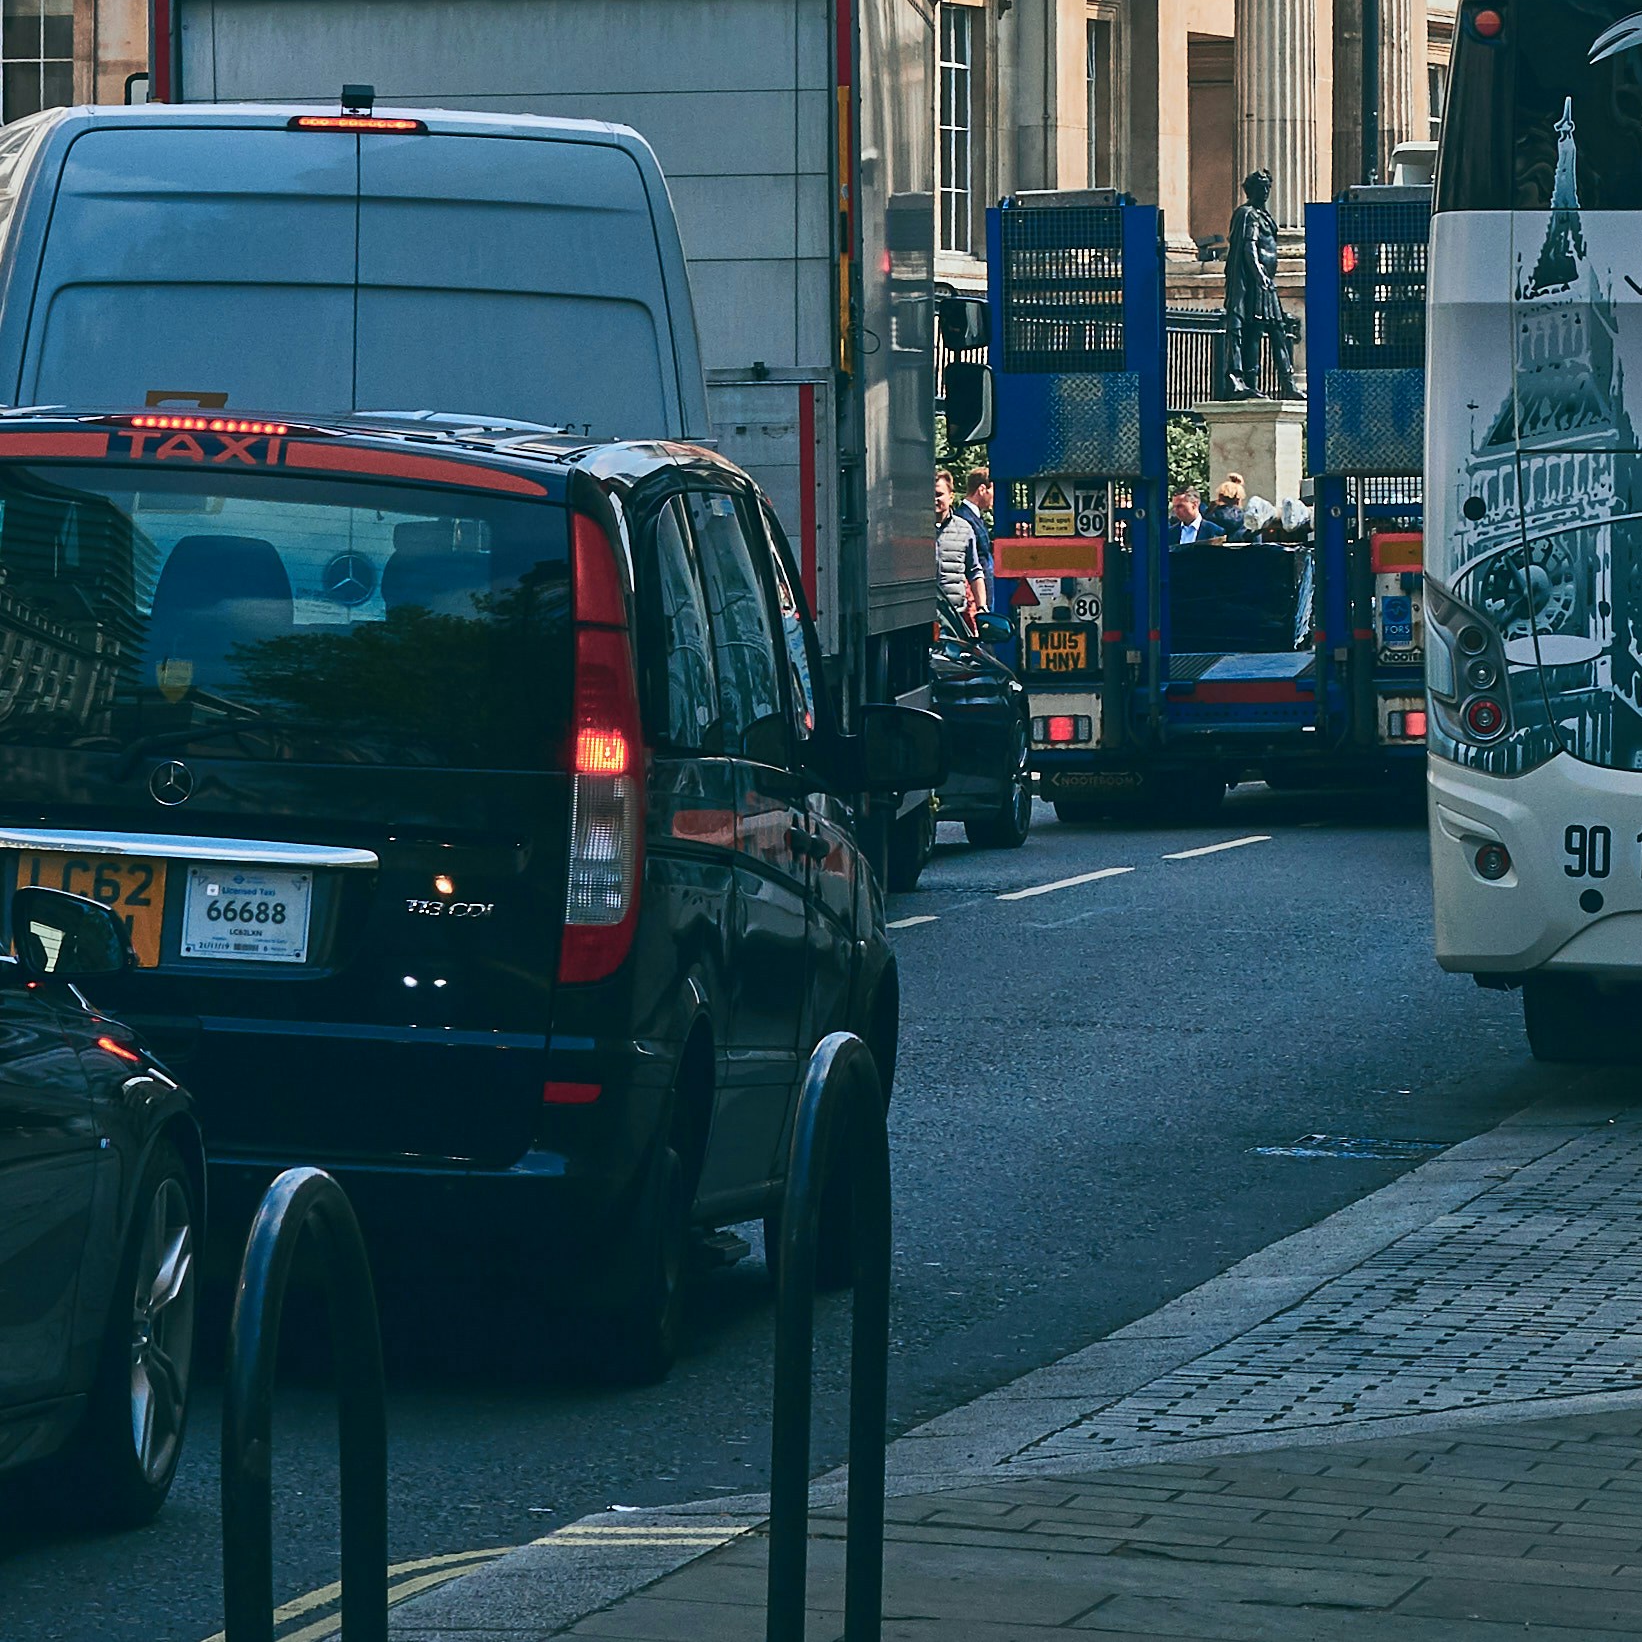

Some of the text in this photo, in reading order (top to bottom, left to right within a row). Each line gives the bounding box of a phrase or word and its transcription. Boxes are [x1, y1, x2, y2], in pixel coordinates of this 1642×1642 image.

[117, 430, 282, 466] TAXI
[1078, 514, 1104, 532] 90
[1075, 599, 1100, 617] 80
[1384, 625, 1410, 634] FORS
[1383, 652, 1424, 662] NOOTE
[1563, 824, 1612, 879] 90
[222, 886, 276, 897] Licensed Taxi
[206, 899, 287, 925] 66688
